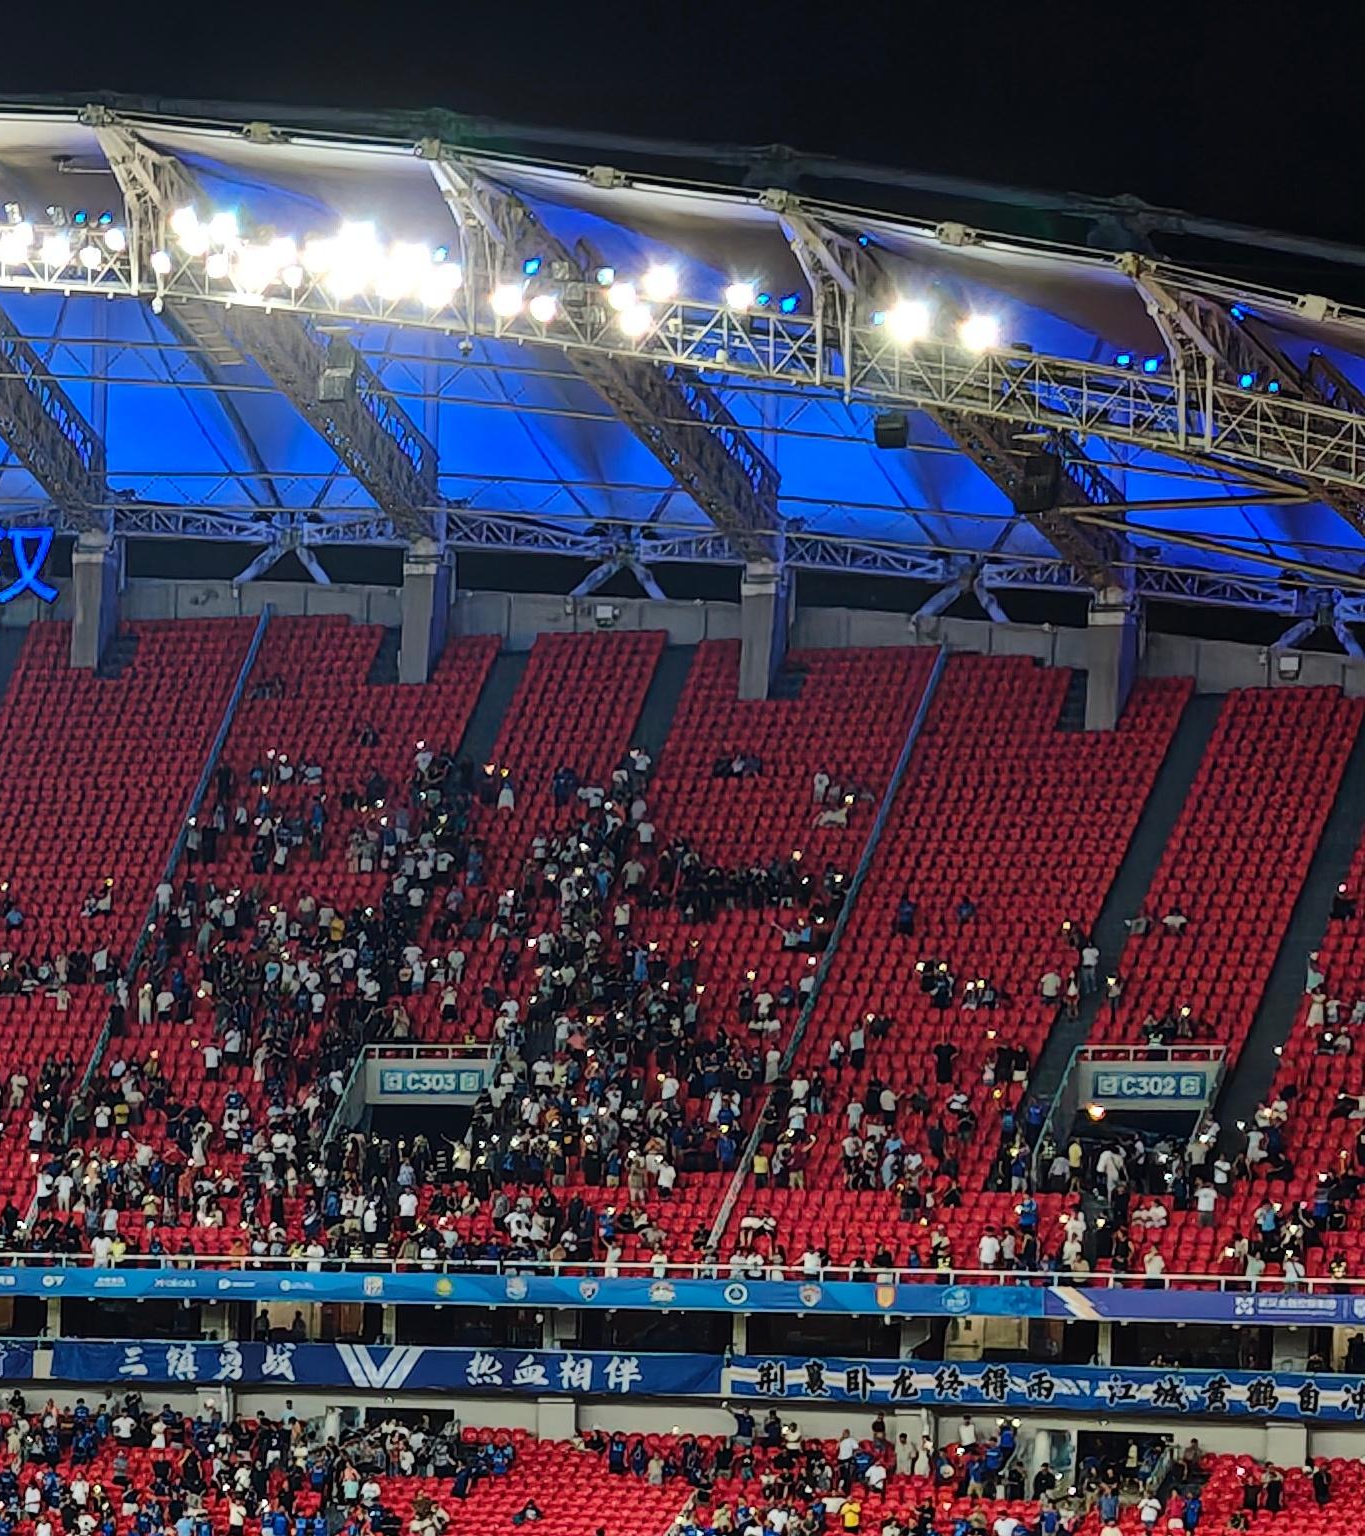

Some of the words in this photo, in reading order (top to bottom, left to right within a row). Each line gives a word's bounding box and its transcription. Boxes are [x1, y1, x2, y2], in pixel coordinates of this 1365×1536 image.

[406, 1073, 457, 1091] C303
[1121, 1075, 1177, 1096] C302
[465, 1351, 644, 1393] 热血相伴
